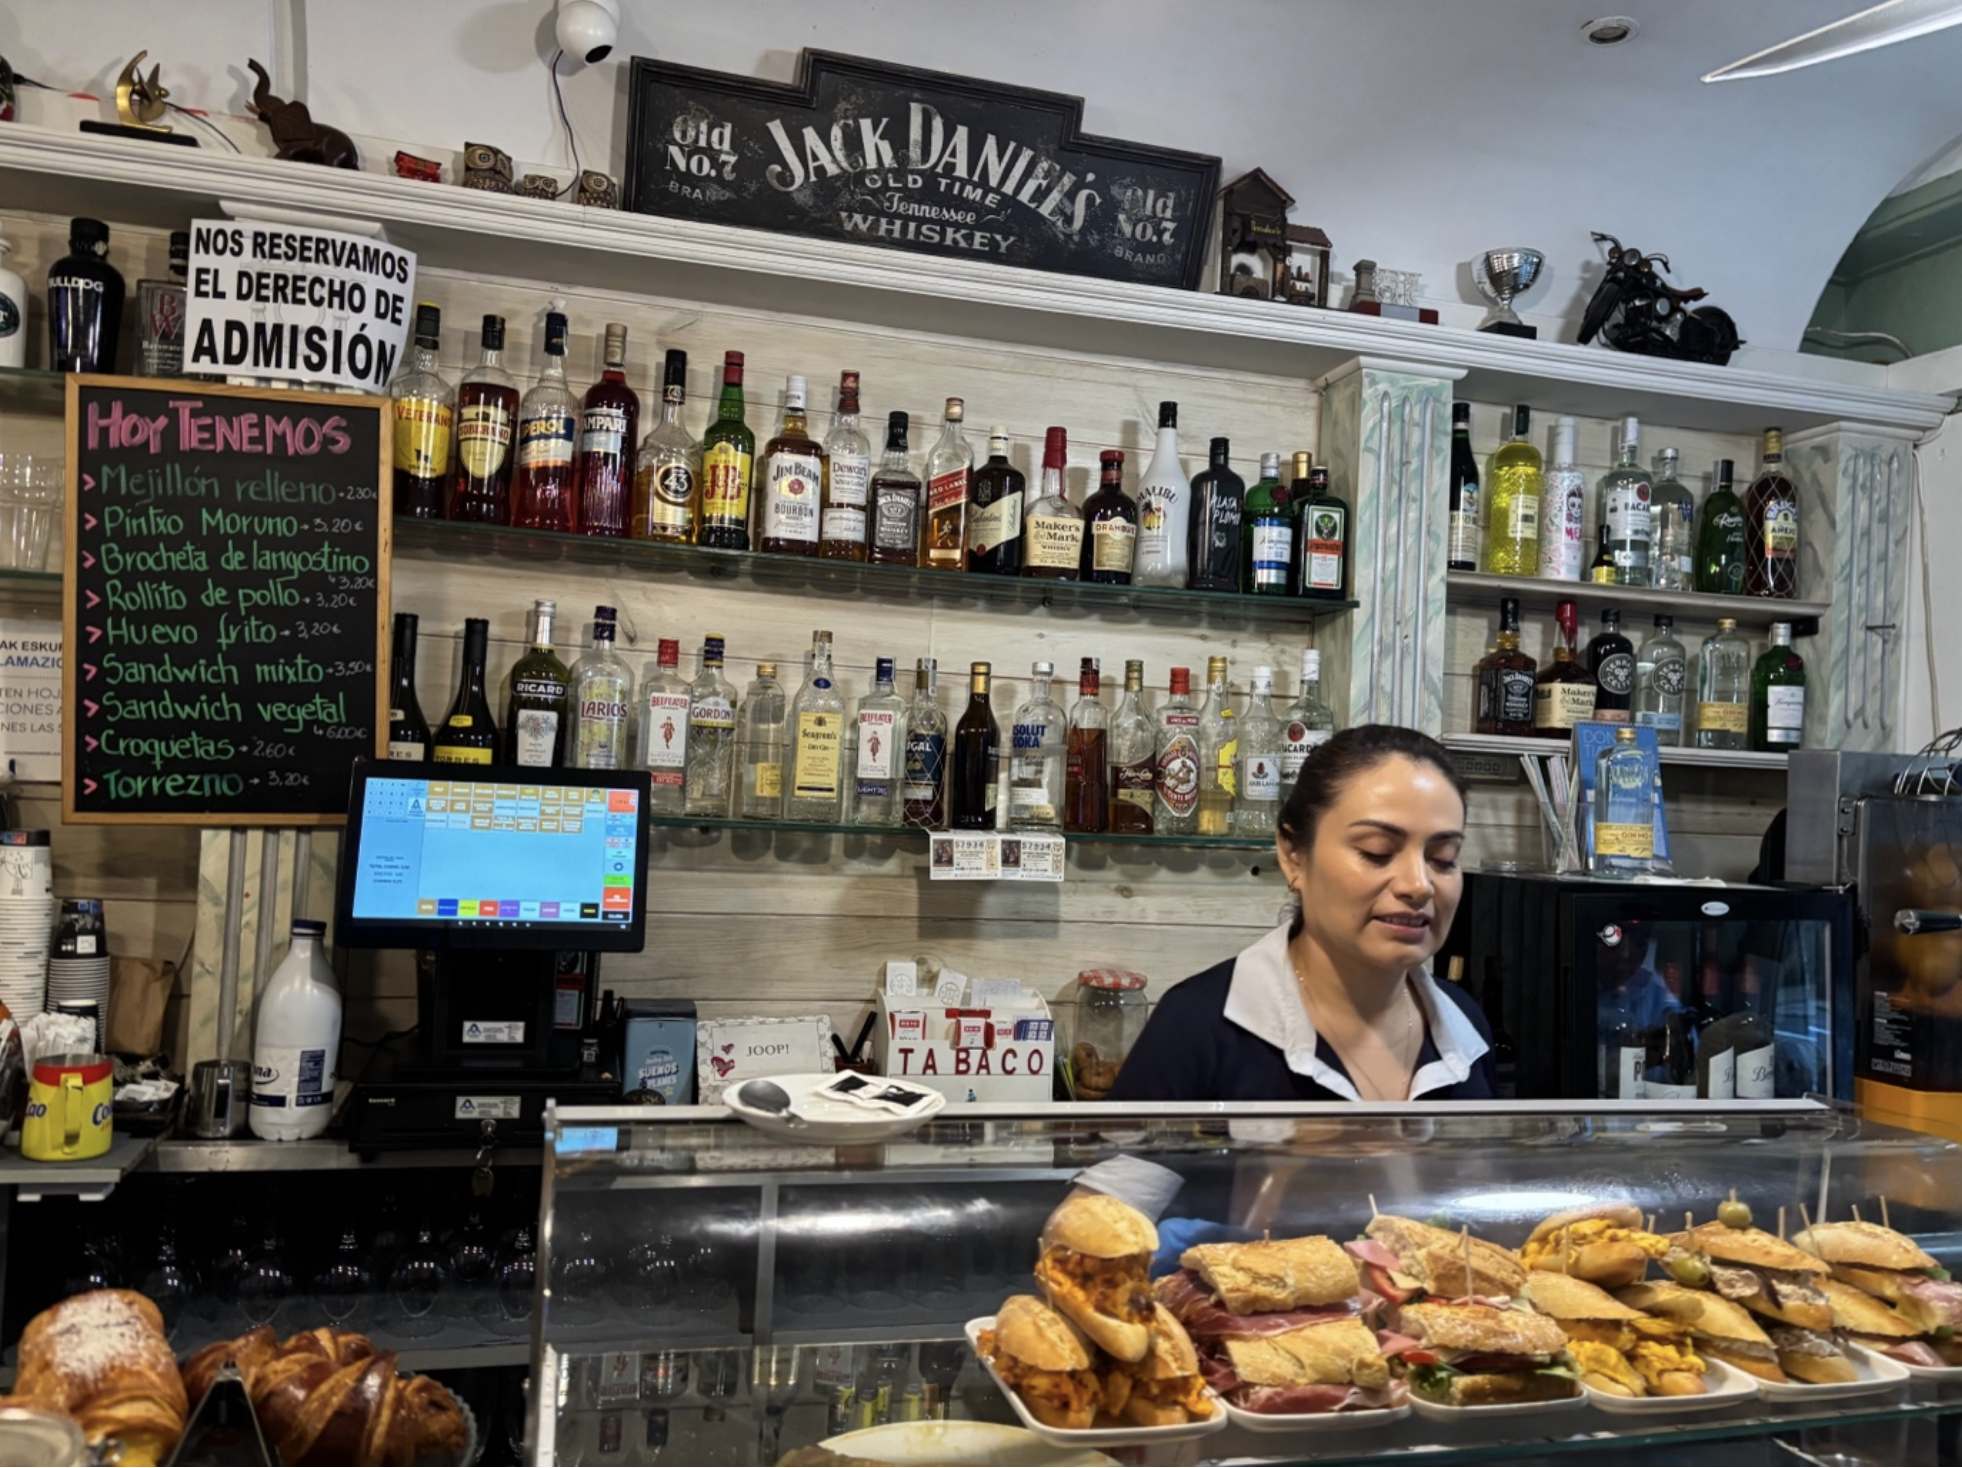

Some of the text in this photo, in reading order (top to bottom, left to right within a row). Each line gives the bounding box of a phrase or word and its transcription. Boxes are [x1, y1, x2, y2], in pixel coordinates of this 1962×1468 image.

[672, 114, 732, 151] Old
[765, 117, 898, 191] JACK
[865, 173, 1002, 209] OLD TIME
[1122, 186, 1176, 219] Old
[883, 191, 977, 224] Tennessee
[838, 211, 1019, 254] WHISKEY
[194, 227, 409, 285] NOS RESERVAMOS
[1113, 245, 1167, 265] BRAND
[194, 267, 405, 327] EL DERECHO DE
[191, 317, 397, 388] ADMISIÓN
[169, 400, 352, 456] TENEMOS
[521, 418, 566, 438] PEROL
[584, 416, 628, 432] AMPARI
[100, 461, 219, 506] Mejillón
[236, 468, 337, 505] relleno
[663, 473, 688, 491] 43
[772, 462, 819, 487] JIM BEAM
[103, 506, 184, 538] Pintxo
[201, 507, 298, 538] Moruno
[774, 502, 814, 518] BOURBON
[1034, 520, 1081, 532] Maker's
[1046, 531, 1079, 543] Mark
[100, 540, 370, 582] Brocheta de langostino
[105, 579, 187, 611] Rollito
[200, 579, 231, 607] de
[239, 578, 300, 616] pollo
[106, 616, 198, 646] Huevo
[217, 612, 277, 651] frito
[102, 653, 239, 685] Sandwich
[255, 653, 324, 684] mixto
[27, 688, 62, 700] HOJ
[515, 683, 564, 695] RICARD
[651, 696, 688, 709] BEEFEATER
[102, 689, 346, 733] Sandwich vegetal
[580, 700, 629, 719] LARIOS
[859, 712, 893, 724] BEEFEATER
[31, 723, 54, 734] LAS
[801, 728, 838, 741] Seagram's
[1013, 724, 1047, 737] SOLUT
[100, 729, 235, 771] Croquetas
[102, 769, 244, 801] Torrezno
[746, 1043, 790, 1058] JOOP!
[898, 1048, 1044, 1076] TABACO
